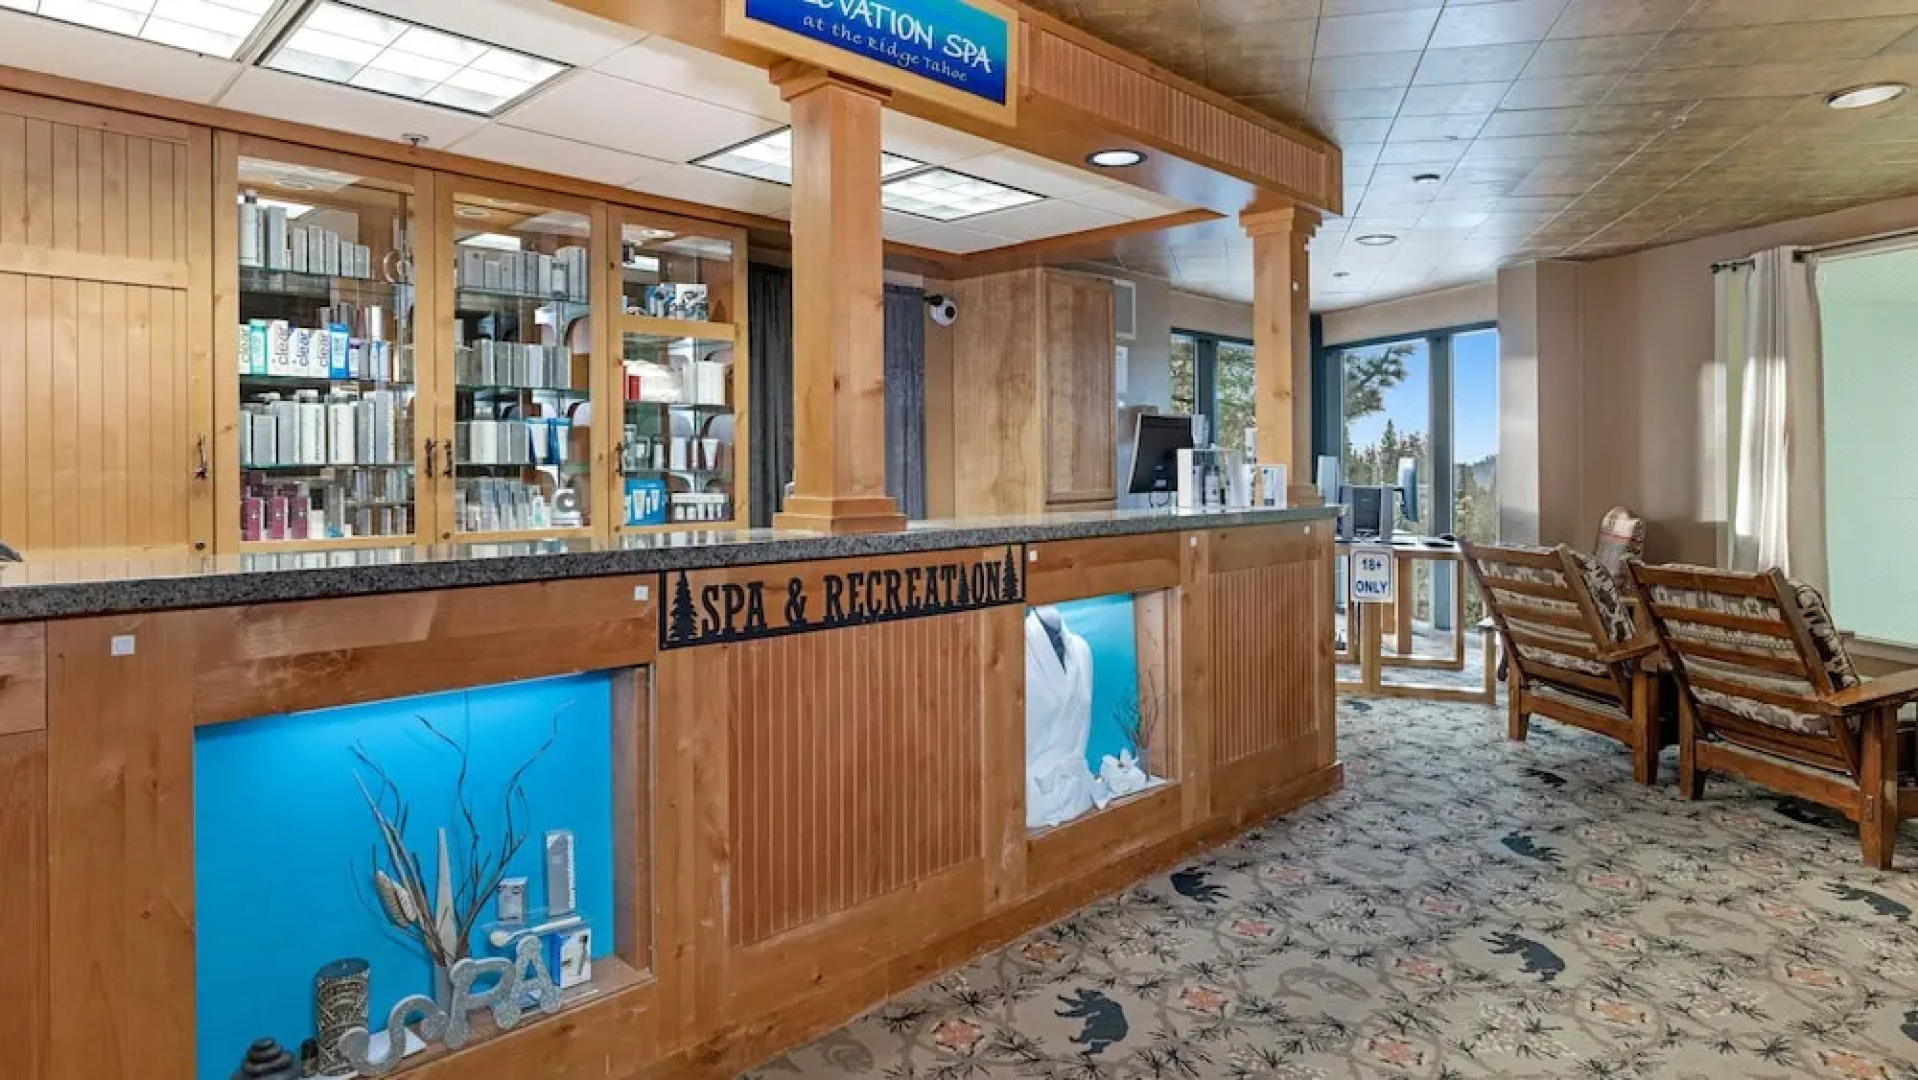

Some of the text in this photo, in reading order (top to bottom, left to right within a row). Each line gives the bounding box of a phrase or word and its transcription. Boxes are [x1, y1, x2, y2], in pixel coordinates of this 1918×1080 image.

[803, 15, 824, 31] at
[832, 23, 861, 45] the
[922, 55, 967, 81] Tahoe
[943, 33, 992, 74] SPA
[275, 324, 288, 365] clear
[1362, 558, 1381, 571] 18+
[701, 580, 768, 637] SPA
[783, 577, 806, 631] &
[1356, 580, 1387, 595] ONLY
[338, 935, 564, 1076] SPA
